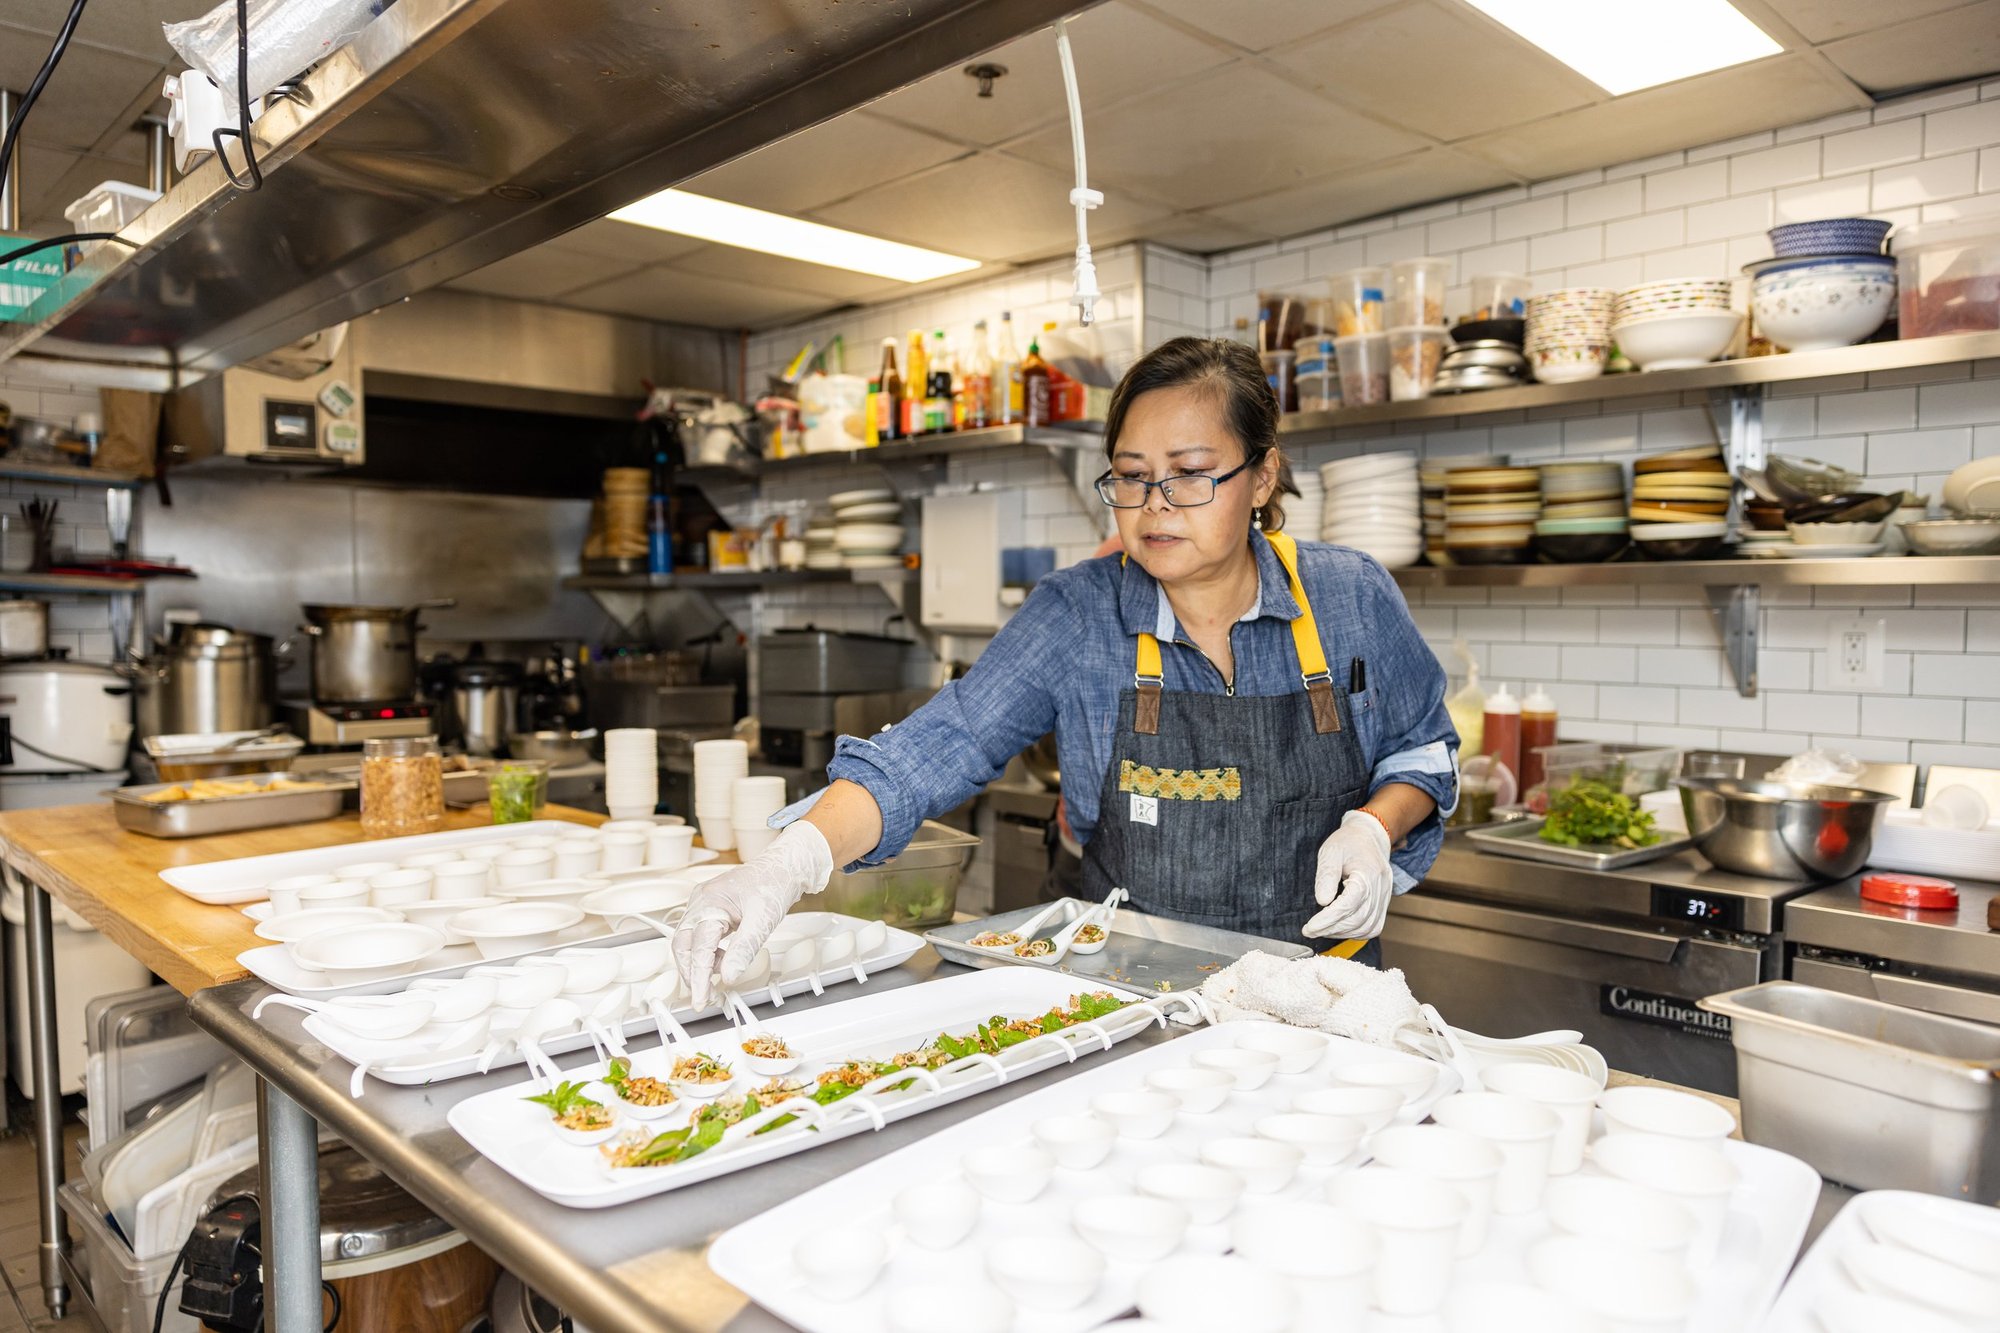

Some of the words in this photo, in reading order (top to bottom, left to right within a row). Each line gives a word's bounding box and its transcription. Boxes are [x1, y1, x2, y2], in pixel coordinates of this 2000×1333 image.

[13, 259, 60, 276] FILM
[1687, 899, 1706, 917] 37
[1609, 987, 1731, 1031] Continenta
